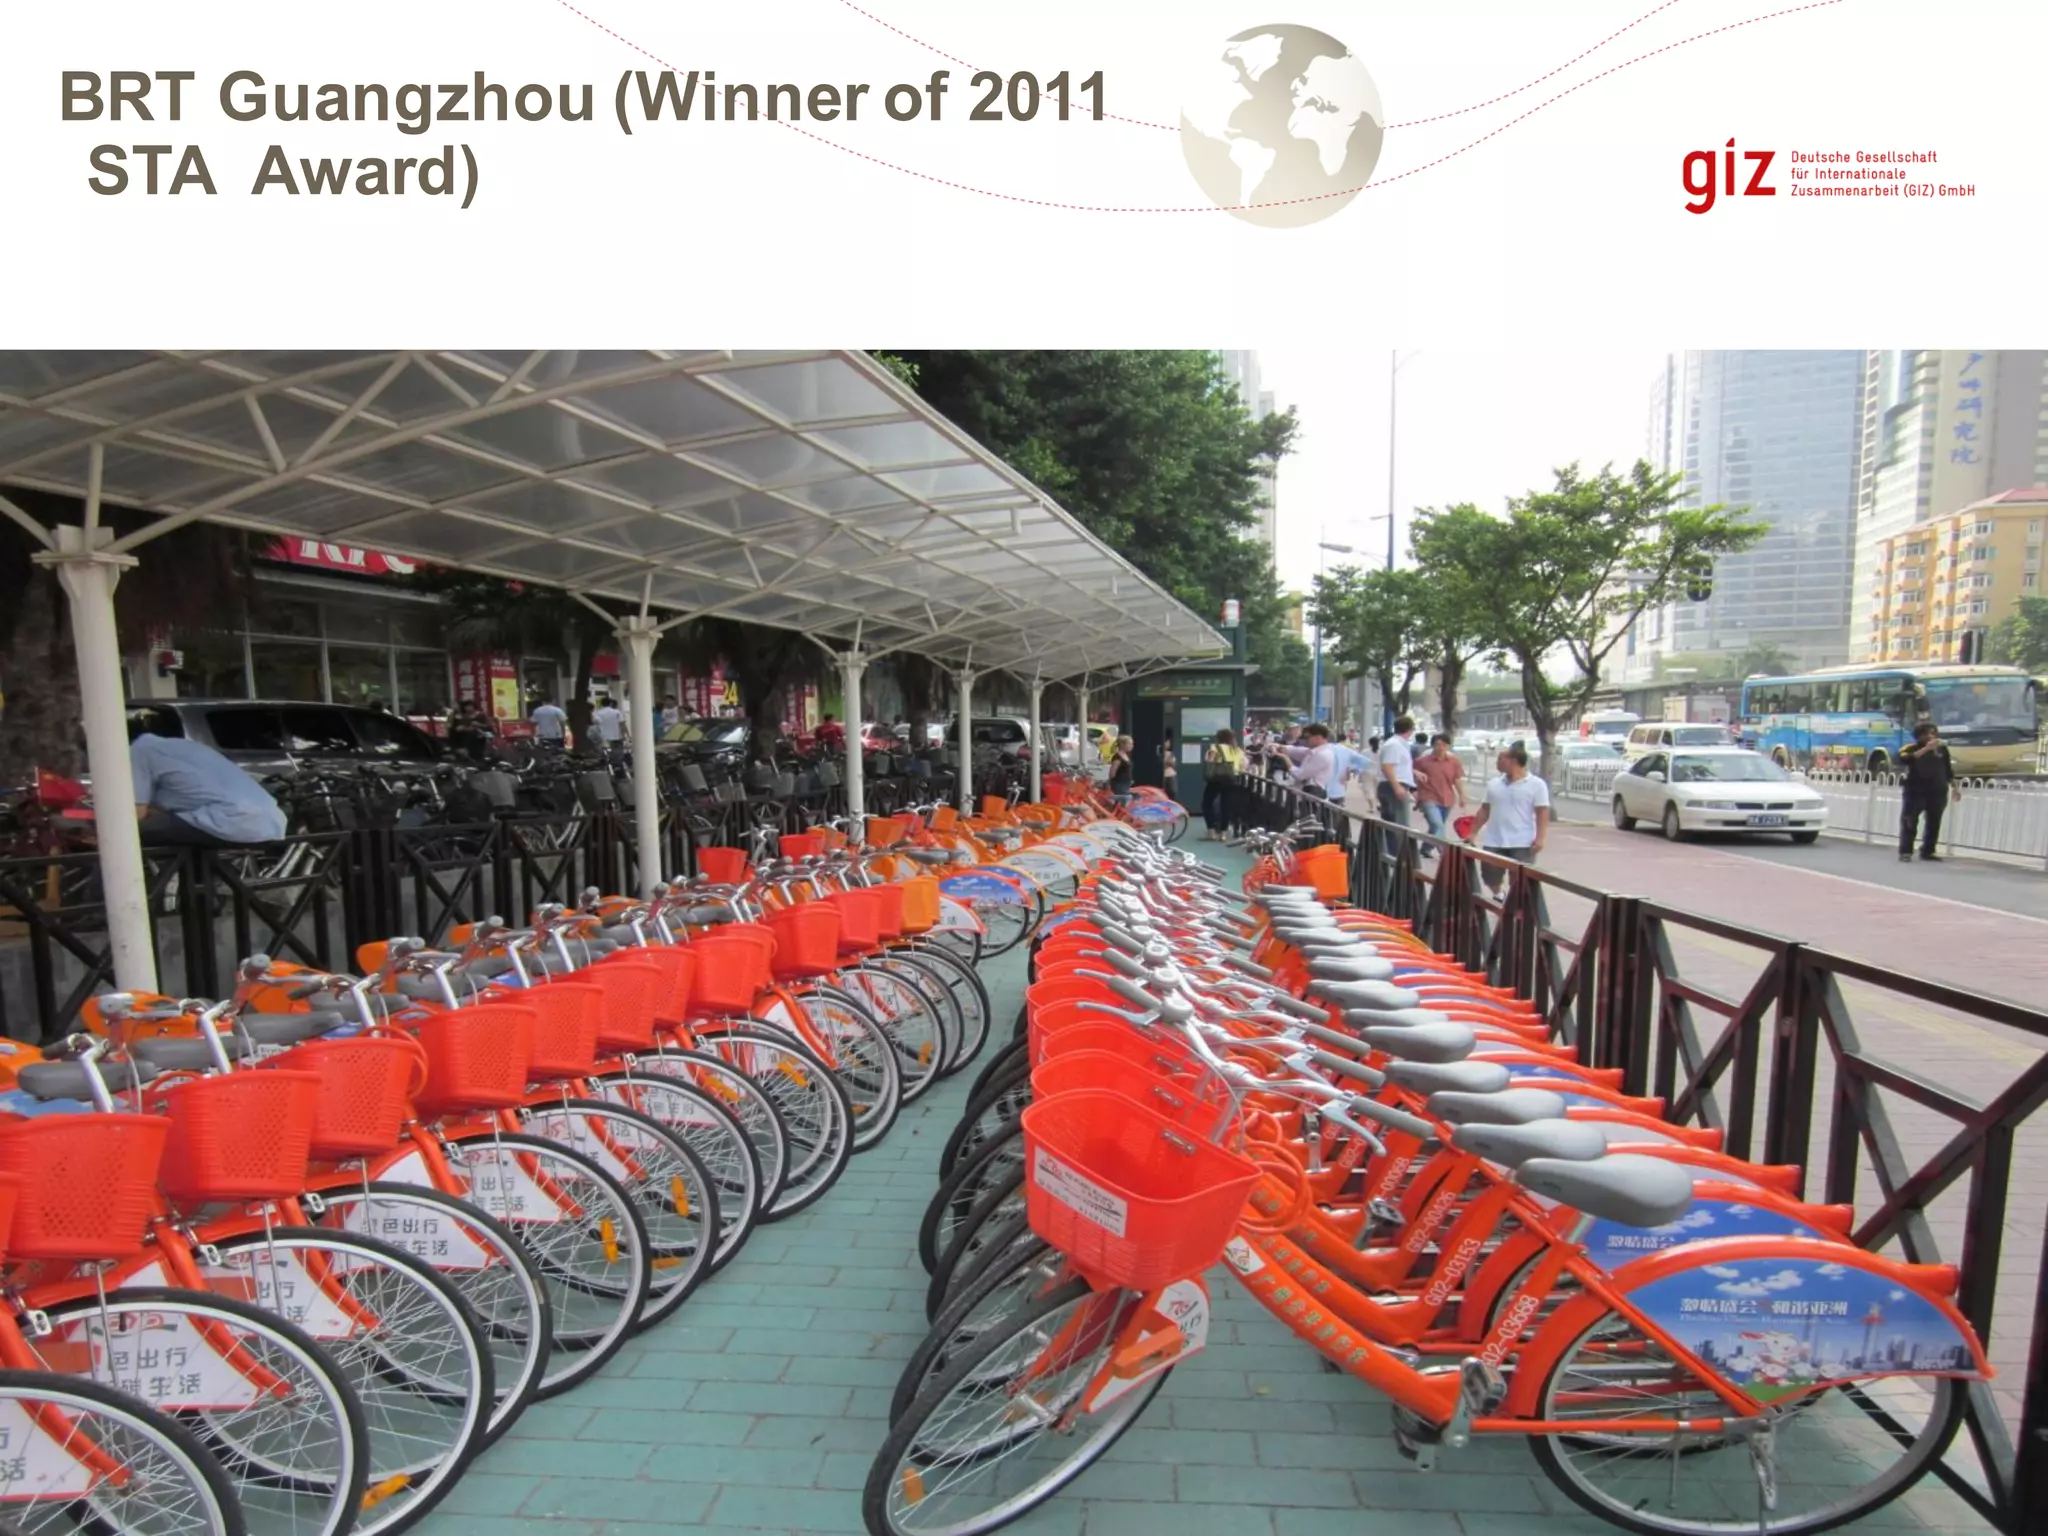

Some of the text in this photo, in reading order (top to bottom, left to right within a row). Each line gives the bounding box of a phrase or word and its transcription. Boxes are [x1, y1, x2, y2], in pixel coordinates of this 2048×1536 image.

[1424, 1238, 1481, 1306] G02-03153
[107, 1346, 188, 1370] 色出行
[114, 1372, 202, 1396] 碳生活
